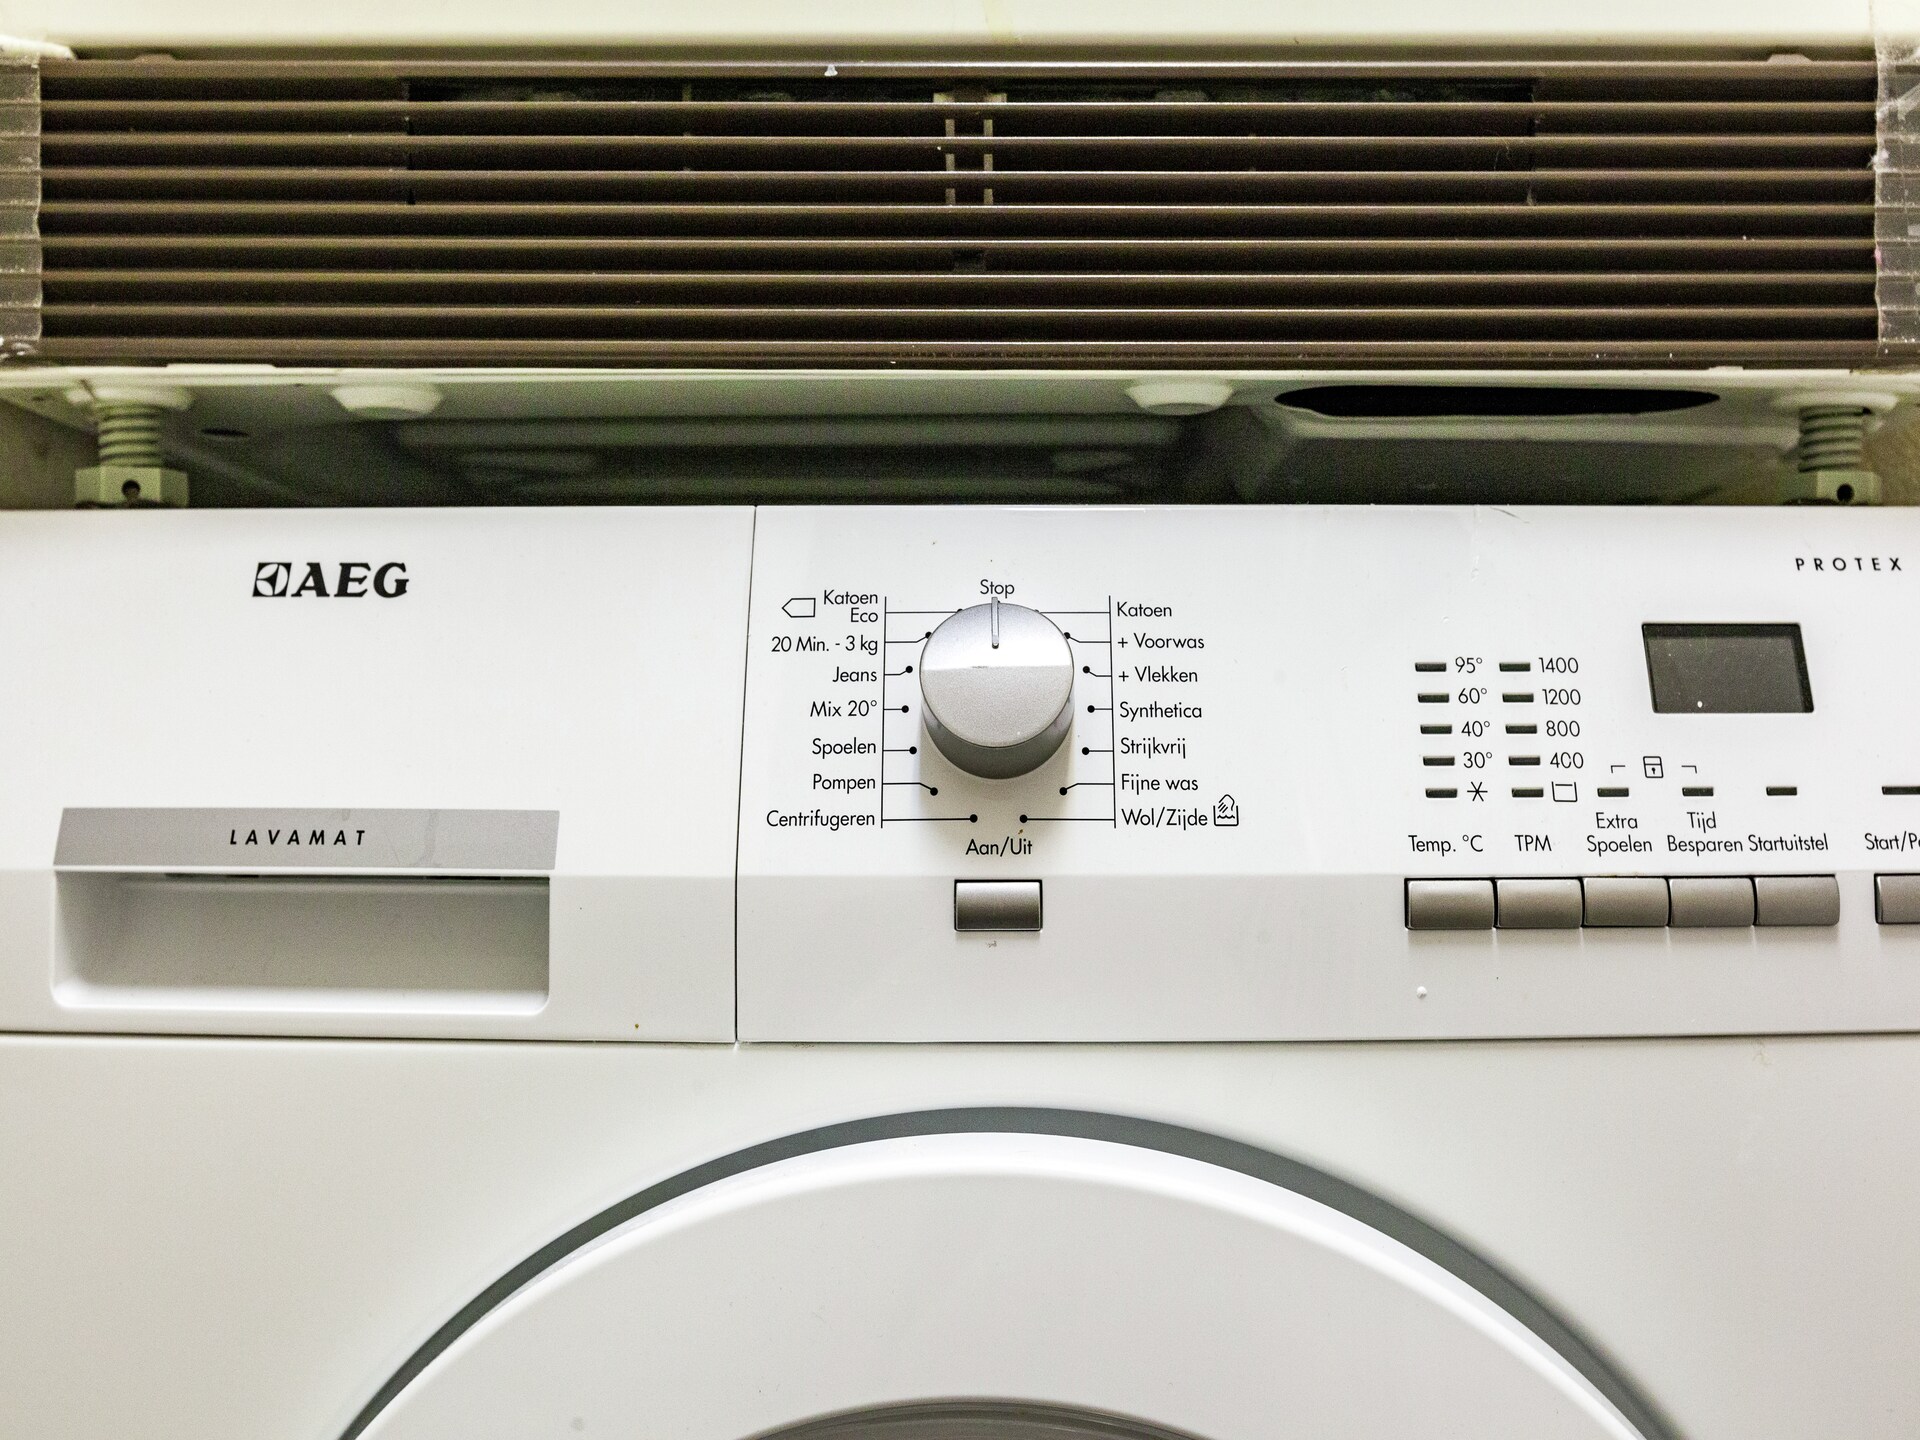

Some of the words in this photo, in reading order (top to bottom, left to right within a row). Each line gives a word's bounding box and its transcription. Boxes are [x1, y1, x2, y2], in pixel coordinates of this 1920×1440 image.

[1795, 557, 1902, 572] PROTEX
[290, 561, 410, 599] AEG
[979, 578, 1015, 597] Stop
[823, 589, 878, 605] Katoen
[850, 606, 879, 623] Eco
[1116, 601, 1173, 618] Katoen
[771, 635, 792, 653] 20
[795, 635, 830, 652] Min.
[845, 634, 856, 652] 3
[860, 634, 878, 656] kg
[1117, 637, 1129, 649] +
[1133, 632, 1205, 649] Voorwas
[832, 666, 878, 683] Jeans
[1118, 670, 1130, 683] +
[1134, 665, 1198, 683] Vlekken
[1455, 656, 1483, 674] 95°
[1538, 656, 1579, 674] 1400
[1457, 687, 1488, 705] 60°
[1542, 688, 1581, 706] 1200
[809, 700, 842, 718] Mix
[847, 699, 878, 717] 20°
[1119, 700, 1203, 723] Synthetica
[1461, 720, 1491, 738] 40°
[1545, 719, 1581, 738] 800
[811, 736, 877, 760] Spoelen
[1120, 736, 1186, 760] Strijkvrij
[1463, 751, 1493, 769] 30°
[1549, 751, 1584, 769] 400
[812, 773, 876, 795] Pompen
[1121, 773, 1161, 796] Fijne
[1165, 779, 1199, 791] was
[766, 808, 875, 832] Centrifugeren
[1120, 806, 1208, 831] Wol/Zijde
[1595, 811, 1638, 830] Extra
[1686, 811, 1717, 834] Tijd
[229, 829, 366, 846] LAVAMAT
[965, 835, 1033, 858] Aan/Uit
[1407, 834, 1457, 857] Temp.
[1514, 834, 1552, 852] TPM
[1586, 834, 1653, 858] Spoelen
[1666, 834, 1744, 857] Besparen
[1747, 832, 1829, 852] Startuitstel
[1864, 830, 1920, 852] Start/P
